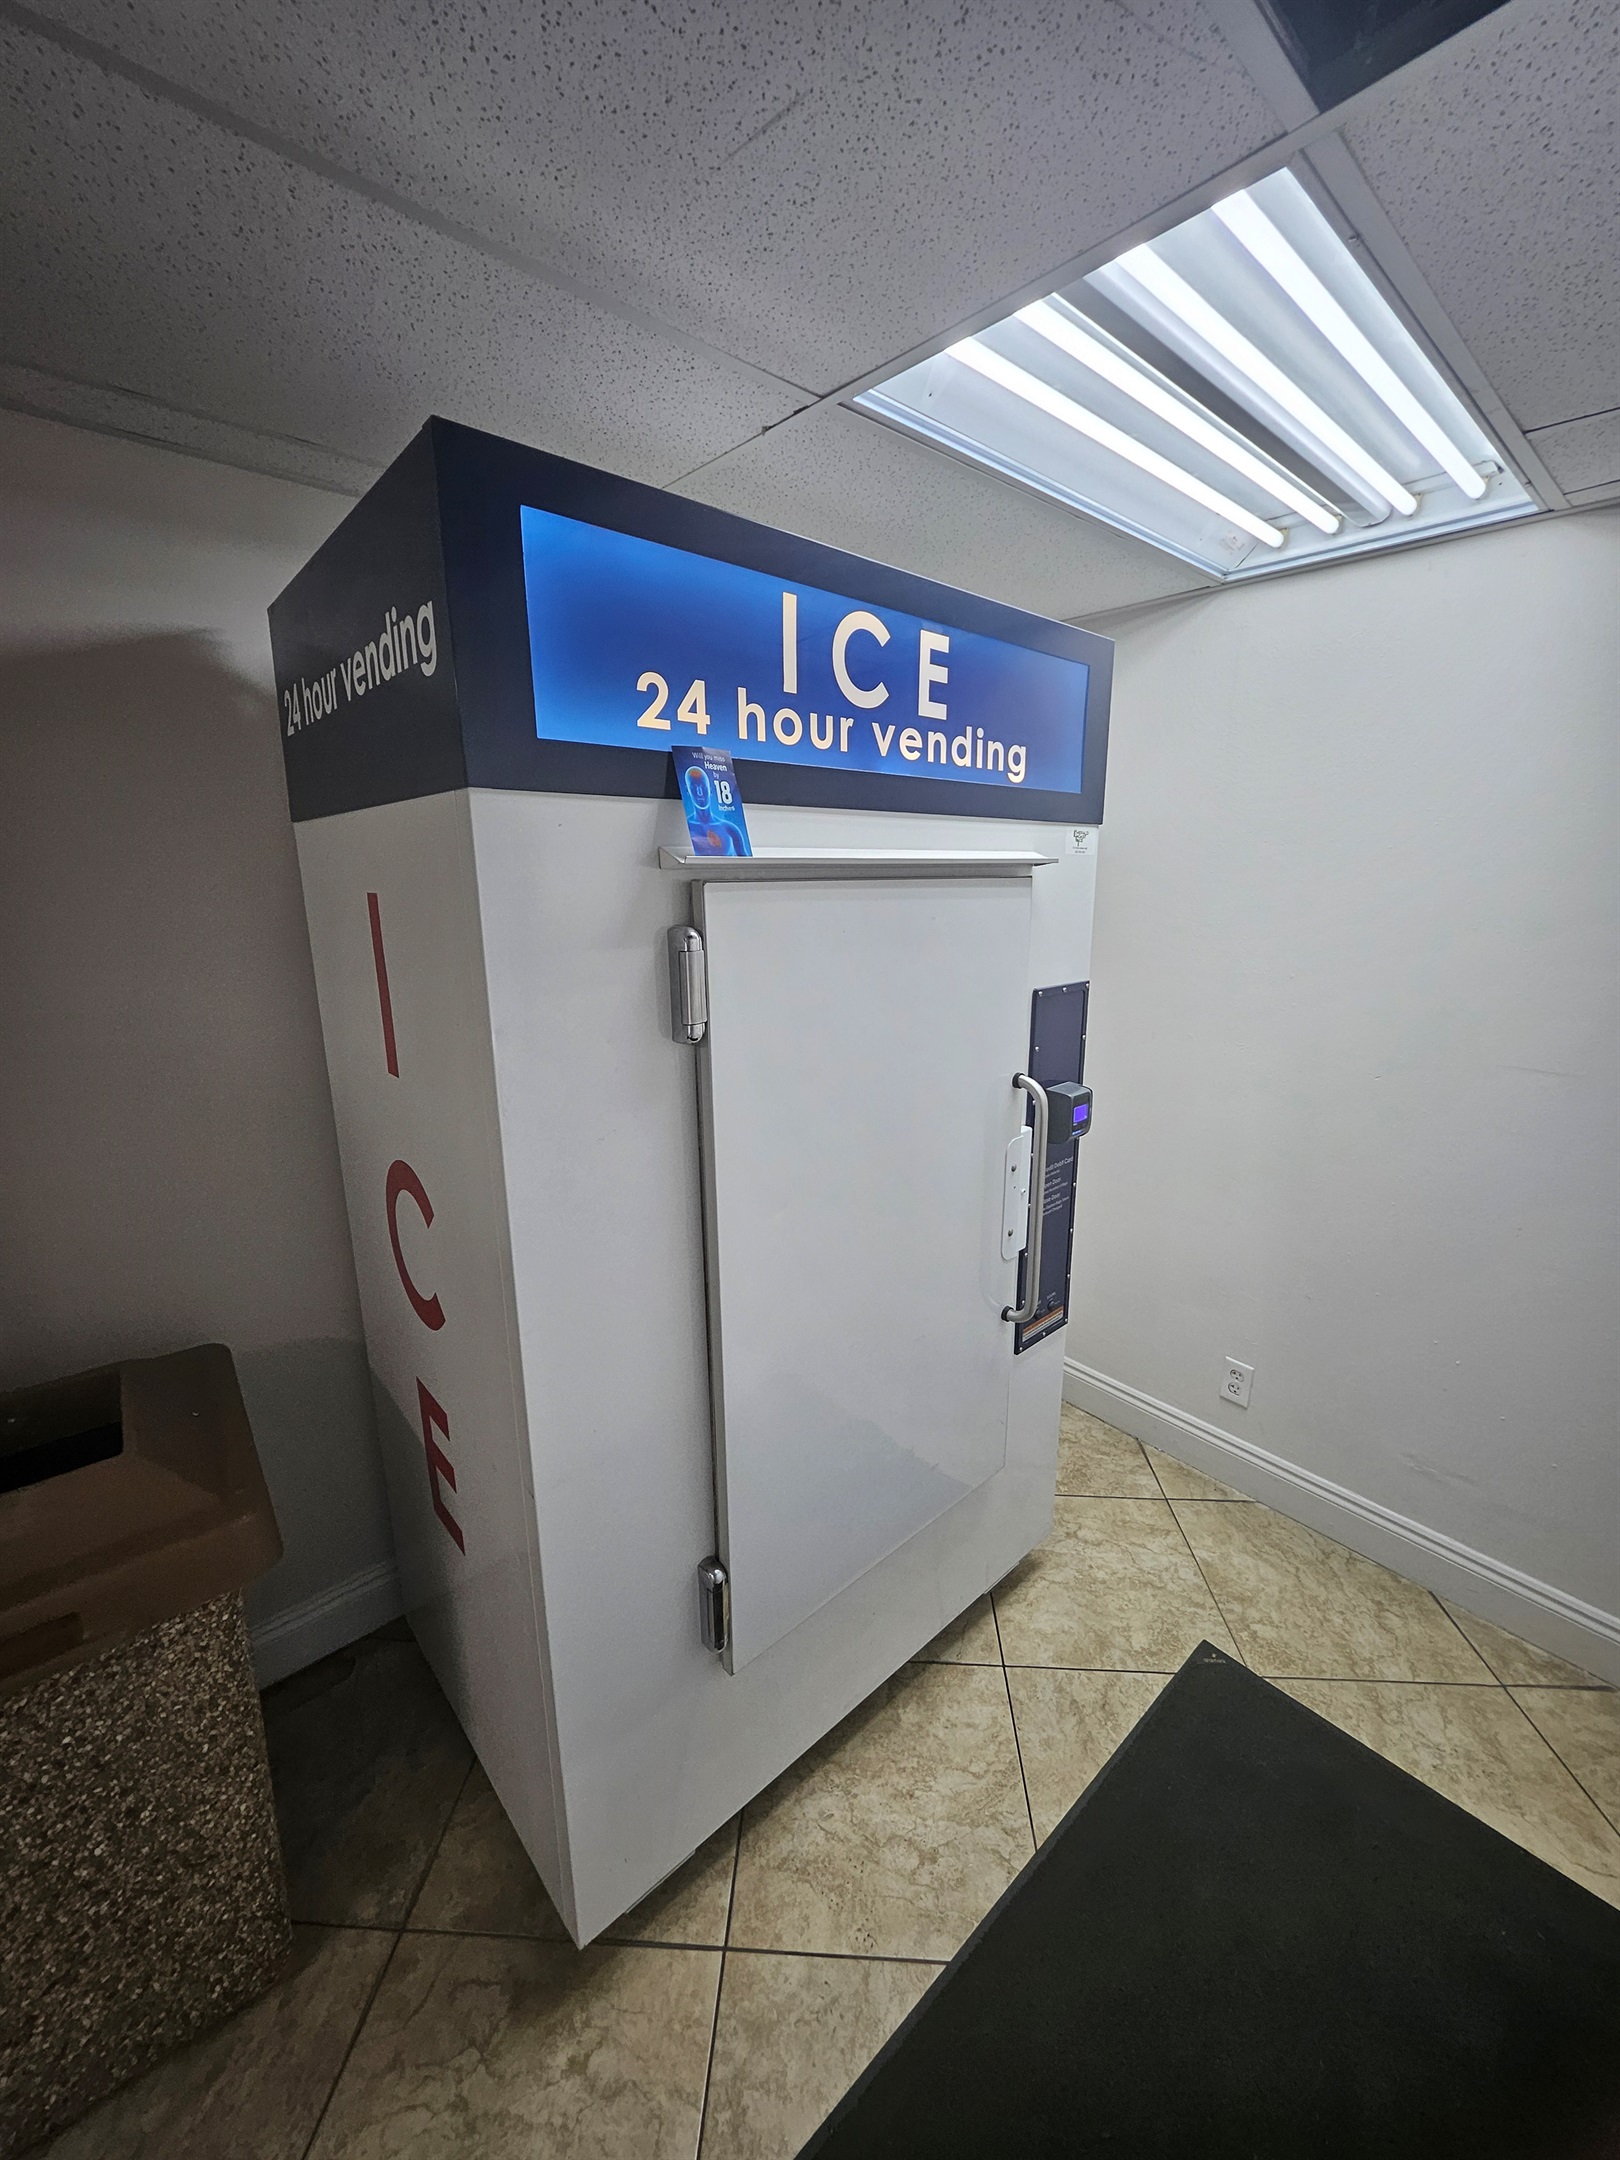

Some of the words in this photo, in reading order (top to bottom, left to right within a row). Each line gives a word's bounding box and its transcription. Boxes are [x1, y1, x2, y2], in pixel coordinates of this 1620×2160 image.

[284, 683, 301, 737] 24
[301, 667, 338, 726] hour
[340, 600, 437, 701] vending
[781, 591, 950, 721] ICE
[635, 670, 712, 736] 24
[737, 686, 854, 753] hour
[871, 725, 1027, 784] vending
[704, 761, 728, 771] Heaven
[712, 771, 720, 780] by
[713, 780, 733, 805] 18
[366, 891, 466, 1557] ICE
